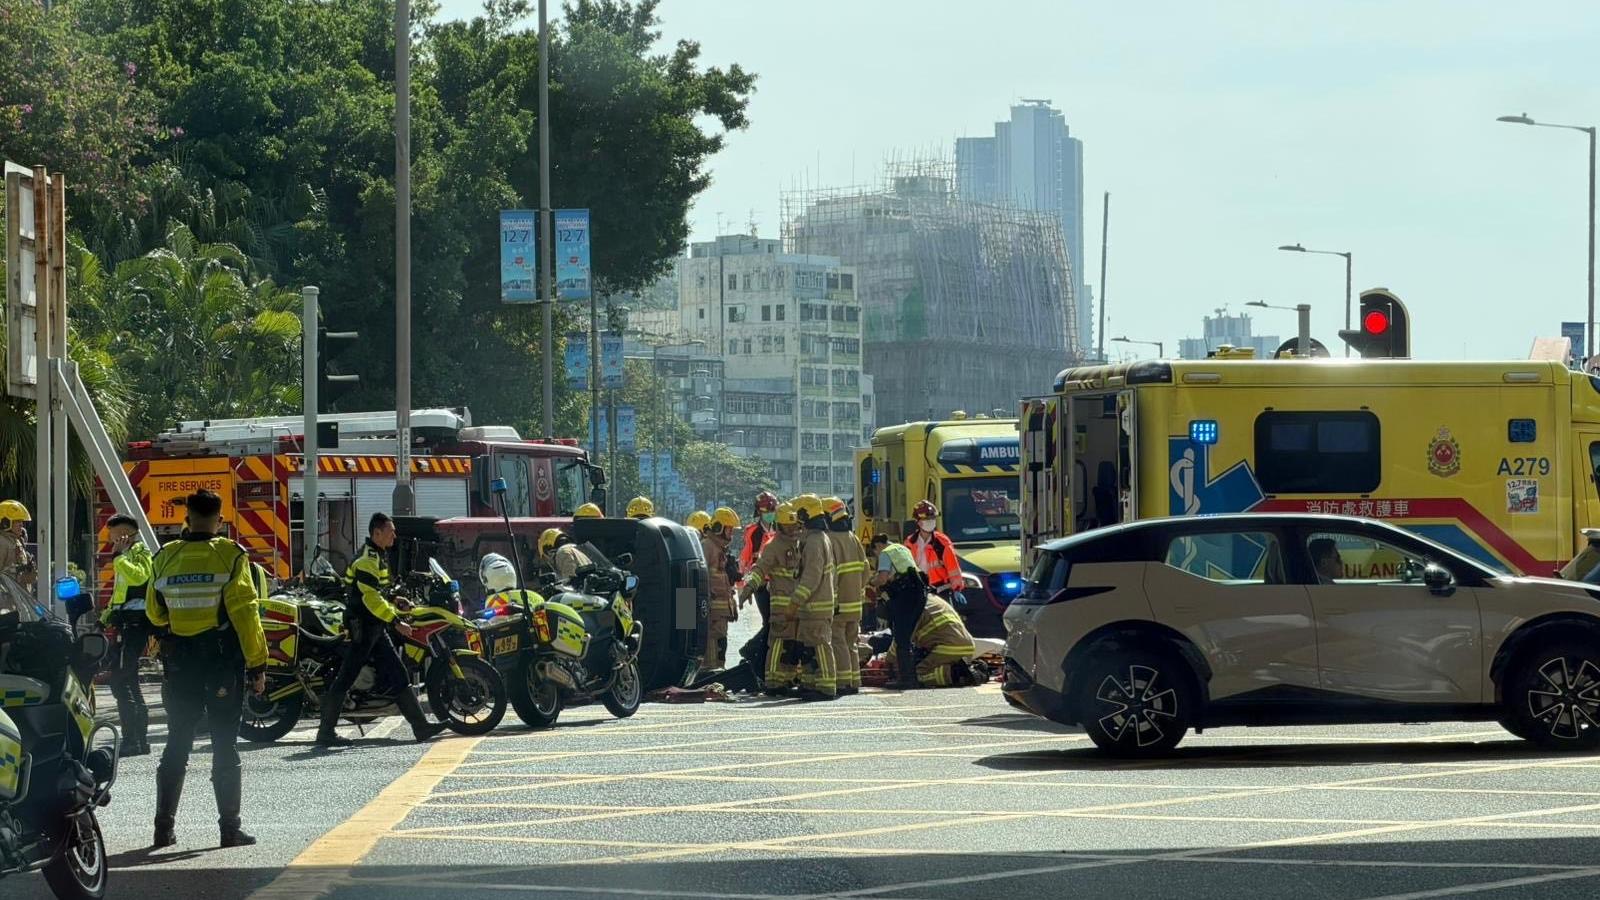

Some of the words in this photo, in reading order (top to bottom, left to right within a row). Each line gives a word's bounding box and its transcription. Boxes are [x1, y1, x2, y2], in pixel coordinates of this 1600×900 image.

[1497, 457, 1550, 476] A279
[159, 481, 178, 492] FIRE
[180, 479, 221, 491] SERVICES
[1306, 500, 1409, 517] 消防處救護車
[176, 574, 203, 584] POLICE
